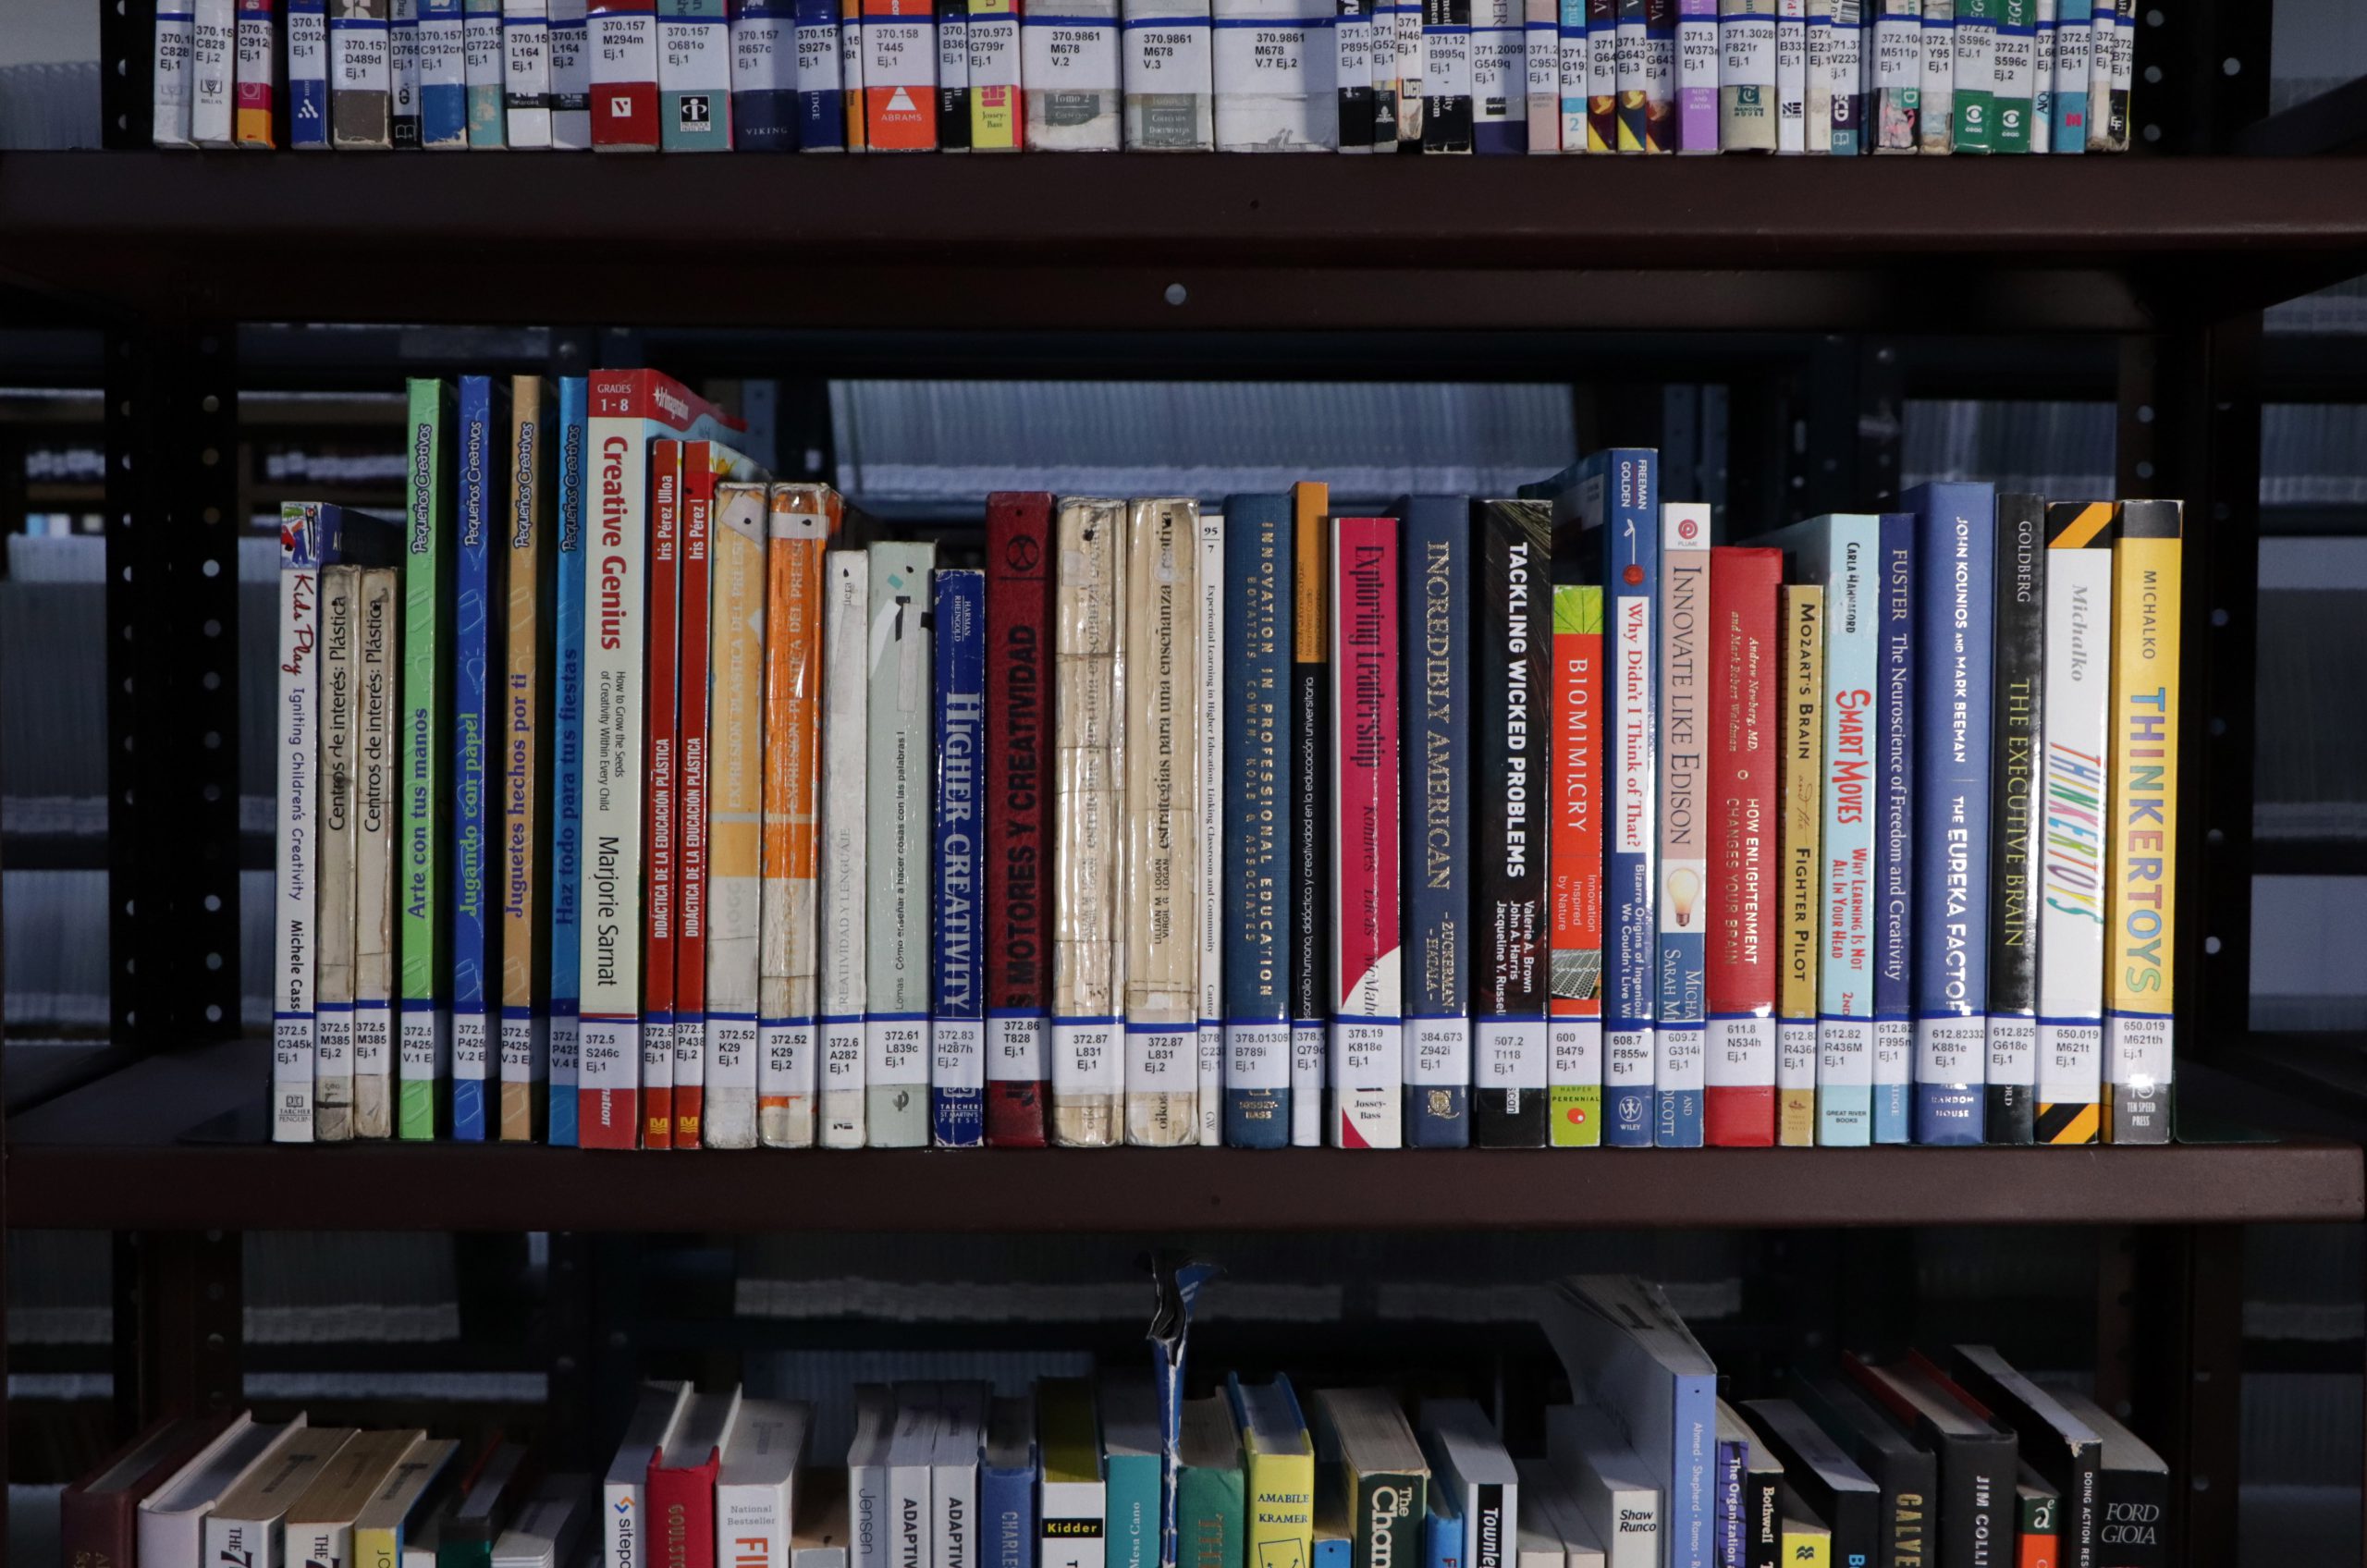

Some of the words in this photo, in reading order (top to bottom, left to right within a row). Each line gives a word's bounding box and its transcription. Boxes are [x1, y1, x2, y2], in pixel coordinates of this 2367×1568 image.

[603, 21, 644, 31] 370.157
[603, 35, 644, 44] M294m
[877, 30, 918, 39] 370.158
[971, 28, 1012, 38] 370.973
[1052, 31, 1100, 42] 370.9861
[1144, 34, 1192, 43] 370.9861
[1429, 36, 1466, 45] 371.12
[1685, 31, 1713, 41] 371.3
[346, 55, 382, 65] D489d
[604, 49, 624, 58] Ej.1
[877, 43, 903, 52] T445
[971, 42, 1004, 52] G799r
[1051, 44, 1080, 54] M678
[1052, 57, 1070, 67] V.2
[1430, 49, 1465, 60] B995q
[1725, 43, 1757, 53] F821r
[1882, 48, 1918, 58] M511p
[1995, 43, 2029, 53] 372.21
[1475, 58, 1511, 70] G549q
[1994, 71, 2014, 80] Ej.2
[881, 114, 922, 122] ABRAMS
[598, 385, 631, 393] GRADES
[415, 423, 432, 489] Creativos
[603, 436, 629, 547] Creative
[658, 475, 672, 504] Ulloa
[1621, 461, 1630, 508] GOLDEN
[1637, 459, 1647, 509] FREEMAN
[411, 489, 430, 553] Pequeños
[657, 507, 672, 539] Pérez
[657, 543, 671, 560] Iris
[2017, 521, 2031, 603] GOLDBERG
[293, 574, 314, 622] Kids
[1262, 522, 1274, 653] INNOVATION
[1348, 545, 1385, 644] Exploring
[1508, 542, 1527, 653] TACKLING
[1892, 549, 1907, 621] FUSTER
[601, 555, 627, 650] Genius
[2141, 570, 2156, 660] MICHALKO
[329, 596, 346, 661] Plástica
[1427, 541, 1450, 724] INCREDIBLY
[1623, 603, 1643, 643] Why
[1672, 566, 1702, 686] INNOVATE
[282, 624, 314, 676] Play
[1798, 604, 1815, 695] MOZART'S
[1892, 633, 1907, 663] The
[600, 670, 611, 680] of
[615, 671, 626, 692] How
[1261, 668, 1274, 688] IN
[1627, 650, 1643, 702] Didn't
[329, 667, 346, 730] interés:
[598, 682, 610, 725] Creativity
[615, 695, 625, 704] to
[1349, 652, 1386, 767] Leadership
[1507, 659, 1527, 750] WICKED
[2009, 680, 2030, 727] THE
[288, 688, 304, 744] Igniting
[615, 706, 625, 731] Grow
[1672, 694, 1694, 745] LIKE
[1798, 704, 1813, 760] BRAIN
[1835, 690, 1871, 756] SMART
[1891, 668, 1907, 772] Neuroscience
[329, 733, 346, 758] de
[414, 708, 428, 779] manos
[460, 712, 482, 772] papel
[599, 728, 610, 757] Within
[615, 734, 625, 748] the
[945, 692, 980, 821] HIGHER
[1567, 658, 1588, 832] BIOMIMICRY
[1626, 719, 1642, 772] Think
[598, 760, 609, 785] Every
[615, 751, 626, 778] Seeds
[654, 739, 669, 787] PLÁSTICA
[290, 752, 304, 821] Children's
[329, 760, 346, 831] Centros
[465, 779, 478, 818] con
[599, 788, 609, 811] Child
[1260, 704, 1274, 864] PROFESSIONAL
[1627, 778, 1642, 796] of
[1670, 753, 1700, 845] EDISON
[1832, 760, 1869, 824] MOVES
[1891, 777, 1907, 793] of
[413, 787, 426, 819] tus
[1427, 730, 1451, 889] AMERICAN
[1506, 757, 1526, 877] PROBLEMS
[1746, 799, 1759, 832] HOW
[2005, 738, 2029, 864] EXECUTIVE
[653, 790, 668, 848] EDUCACIÓN
[1626, 801, 1643, 848] That?
[1890, 795, 1906, 862] Freedom
[413, 828, 426, 865] con
[2126, 687, 2166, 993] THINKERTOYS
[289, 828, 304, 900] Creativity
[460, 826, 481, 918] Jugando
[655, 851, 668, 864] LA
[655, 866, 668, 881] DE
[595, 837, 619, 918] Marjorie
[1795, 847, 1810, 923] FIGHTER
[1889, 867, 1905, 896] and
[407, 873, 426, 919] Arte
[652, 884, 668, 938] DIDÁCTICA
[1588, 875, 1597, 932] Innovation
[1744, 838, 1759, 964] ENLIGHTENMENT
[2005, 875, 2027, 947] BRAIN
[943, 833, 971, 1011] CREATIVITY
[1524, 900, 1535, 940] Valerie
[290, 919, 303, 974] Michele
[1259, 878, 1273, 996] EDUCATION
[1524, 942, 1534, 954] A.
[1884, 900, 1905, 981] Creativity
[597, 925, 619, 986] Sarnat
[1794, 930, 1809, 982] PILOT
[1523, 957, 1534, 993] Brown
[278, 1026, 306, 1035] 372.5
[278, 1040, 313, 1049] C345k
[321, 1035, 350, 1045] M385
[586, 1035, 615, 1044] 372.5
[719, 1030, 754, 1040] 372.52
[885, 1032, 918, 1040] 372.61
[1004, 1035, 1030, 1043] T828
[1348, 1029, 1383, 1038] 378.19
[1349, 1042, 1381, 1051] K818e
[1556, 1033, 1576, 1042] 600
[1613, 1035, 1641, 1045] 608.7
[1993, 1027, 2034, 1036] 612.825
[1993, 1041, 2027, 1050] G618e
[2124, 1035, 2163, 1045] M621th
[586, 1048, 619, 1058] S246c
[830, 1050, 857, 1060] A282
[1556, 1047, 1584, 1055] B479
[1613, 1049, 1648, 1059] F855w
[1825, 1043, 1862, 1052] R436M
[1693, 1423, 1703, 1456] Ahmed
[1257, 1494, 1309, 1504] AMABILE
[1976, 1476, 1989, 1507] JIM
[2082, 1472, 2092, 1503] DOING
[728, 1516, 776, 1526] Bestseller
[730, 1504, 772, 1514] National
[859, 1488, 877, 1555] Jensen
[1258, 1513, 1307, 1524] KRAMER
[1620, 1509, 1653, 1521] Shaw
[1762, 1487, 1774, 1543] Bothwell
[2104, 1503, 2160, 1523] FORD
[1048, 1523, 1097, 1533] Kidder
[1620, 1522, 1656, 1533] Runco
[2081, 1507, 2091, 1545] ACTION
[2101, 1525, 2157, 1545] GIOIA
